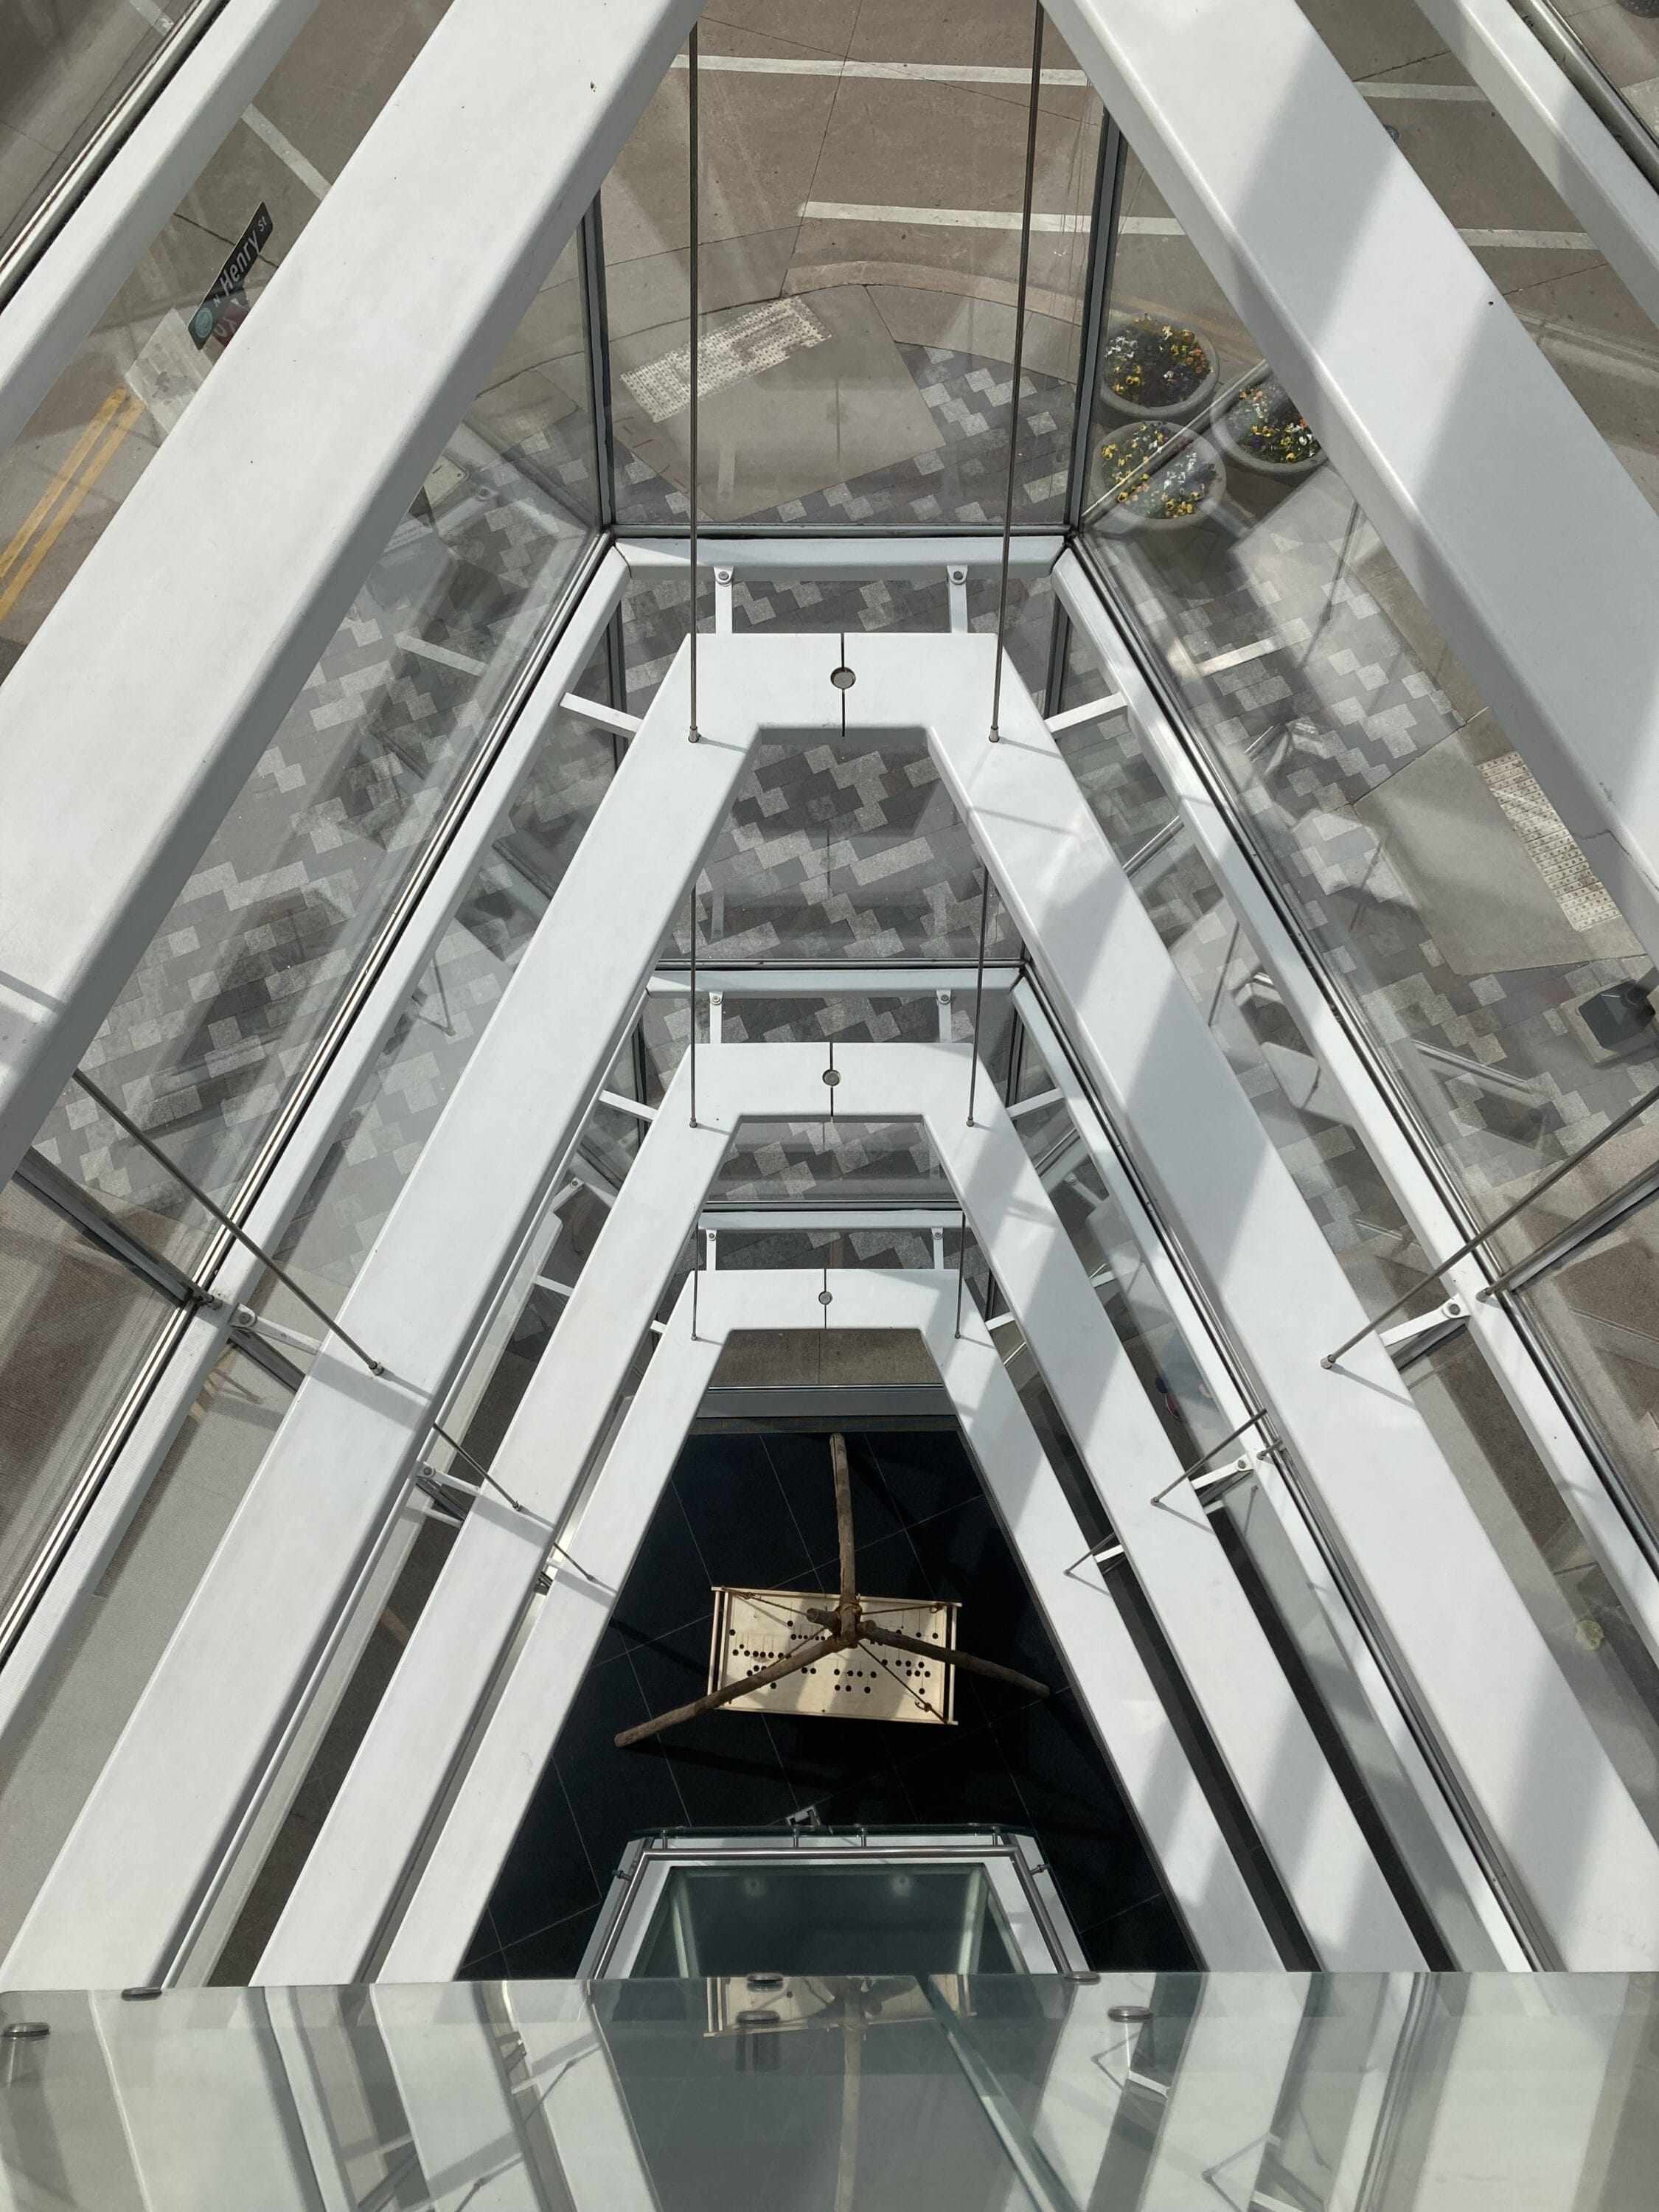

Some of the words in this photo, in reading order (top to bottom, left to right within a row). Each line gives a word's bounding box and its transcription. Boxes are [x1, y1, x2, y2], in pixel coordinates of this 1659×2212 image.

[212, 296, 222, 308] N
[219, 229, 261, 296] Henry
[257, 215, 268, 232] St
